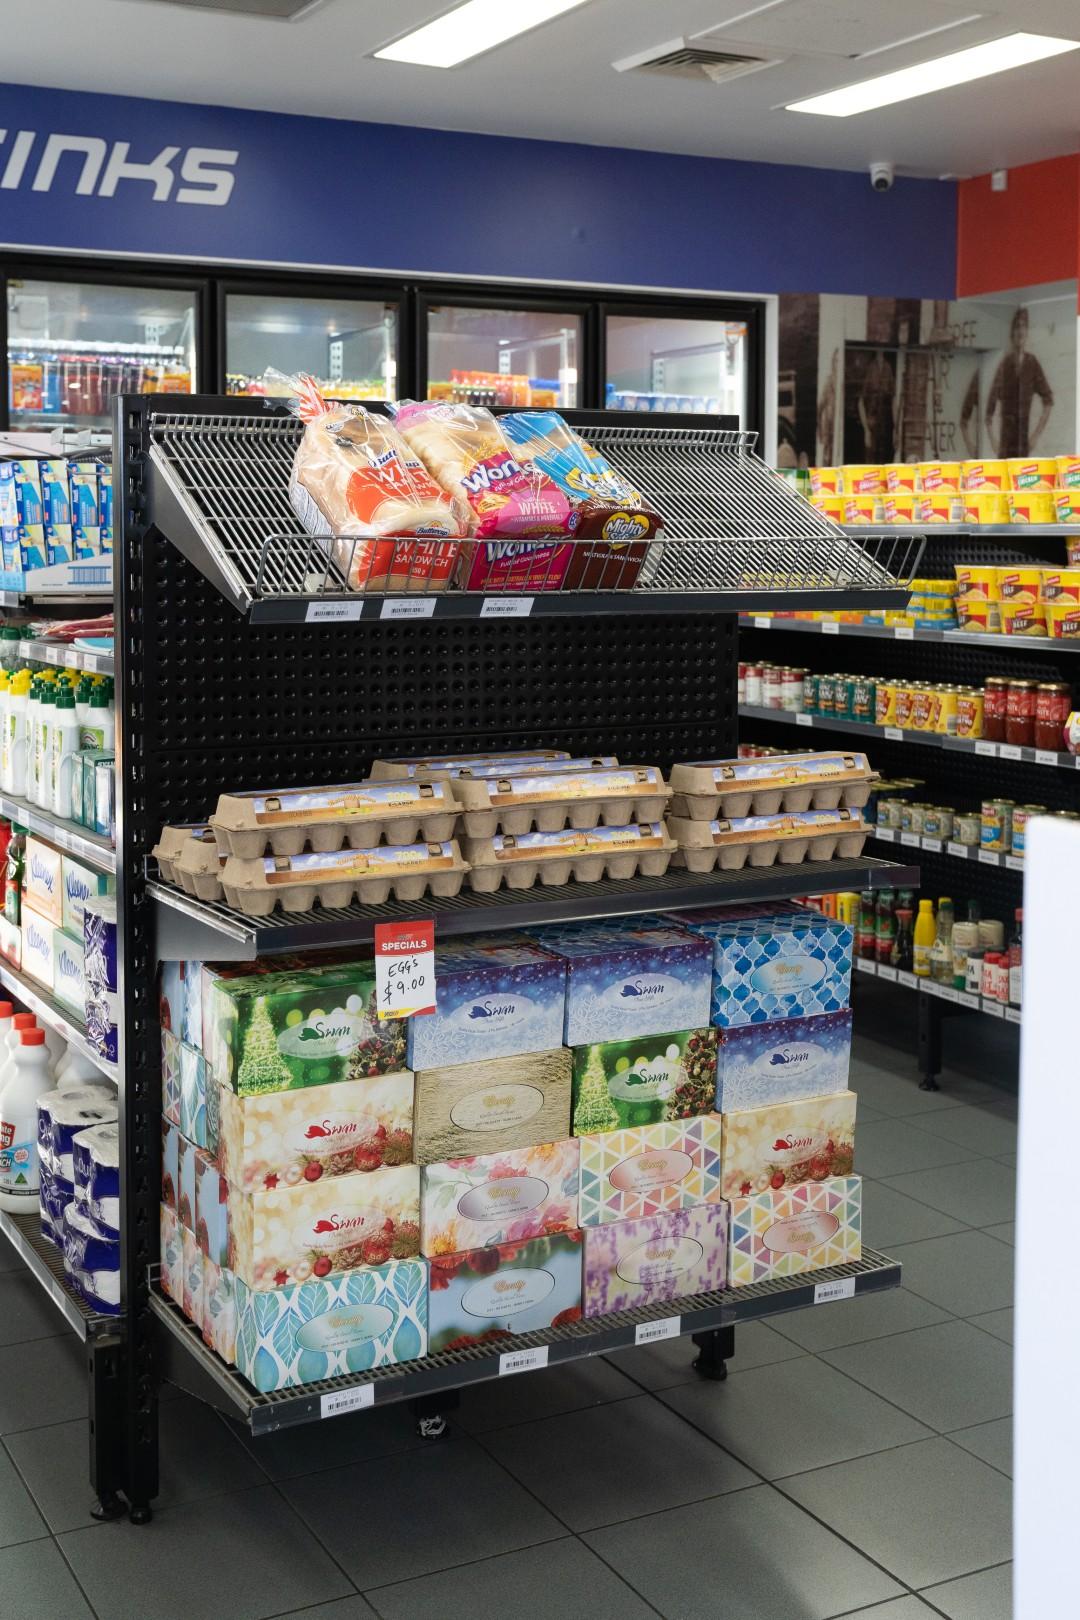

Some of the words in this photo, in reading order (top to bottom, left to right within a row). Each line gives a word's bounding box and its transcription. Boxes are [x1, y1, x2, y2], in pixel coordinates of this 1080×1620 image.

[0, 128, 239, 206] INKS
[416, 526, 449, 537] Buttercup
[606, 519, 646, 536] Mighty
[394, 555, 449, 568] SANDWCH
[30, 853, 54, 894] Kleenex
[65, 870, 93, 902] Kleene
[381, 940, 427, 951] SPECIALS
[634, 980, 665, 996] Swan
[484, 1000, 515, 1017] Swan
[315, 1021, 351, 1039] Swan
[782, 1048, 809, 1063] Swan
[639, 1068, 669, 1083] Swan
[322, 1119, 357, 1136] Swan
[785, 1134, 813, 1149] Swan
[330, 1213, 365, 1231] Swan
